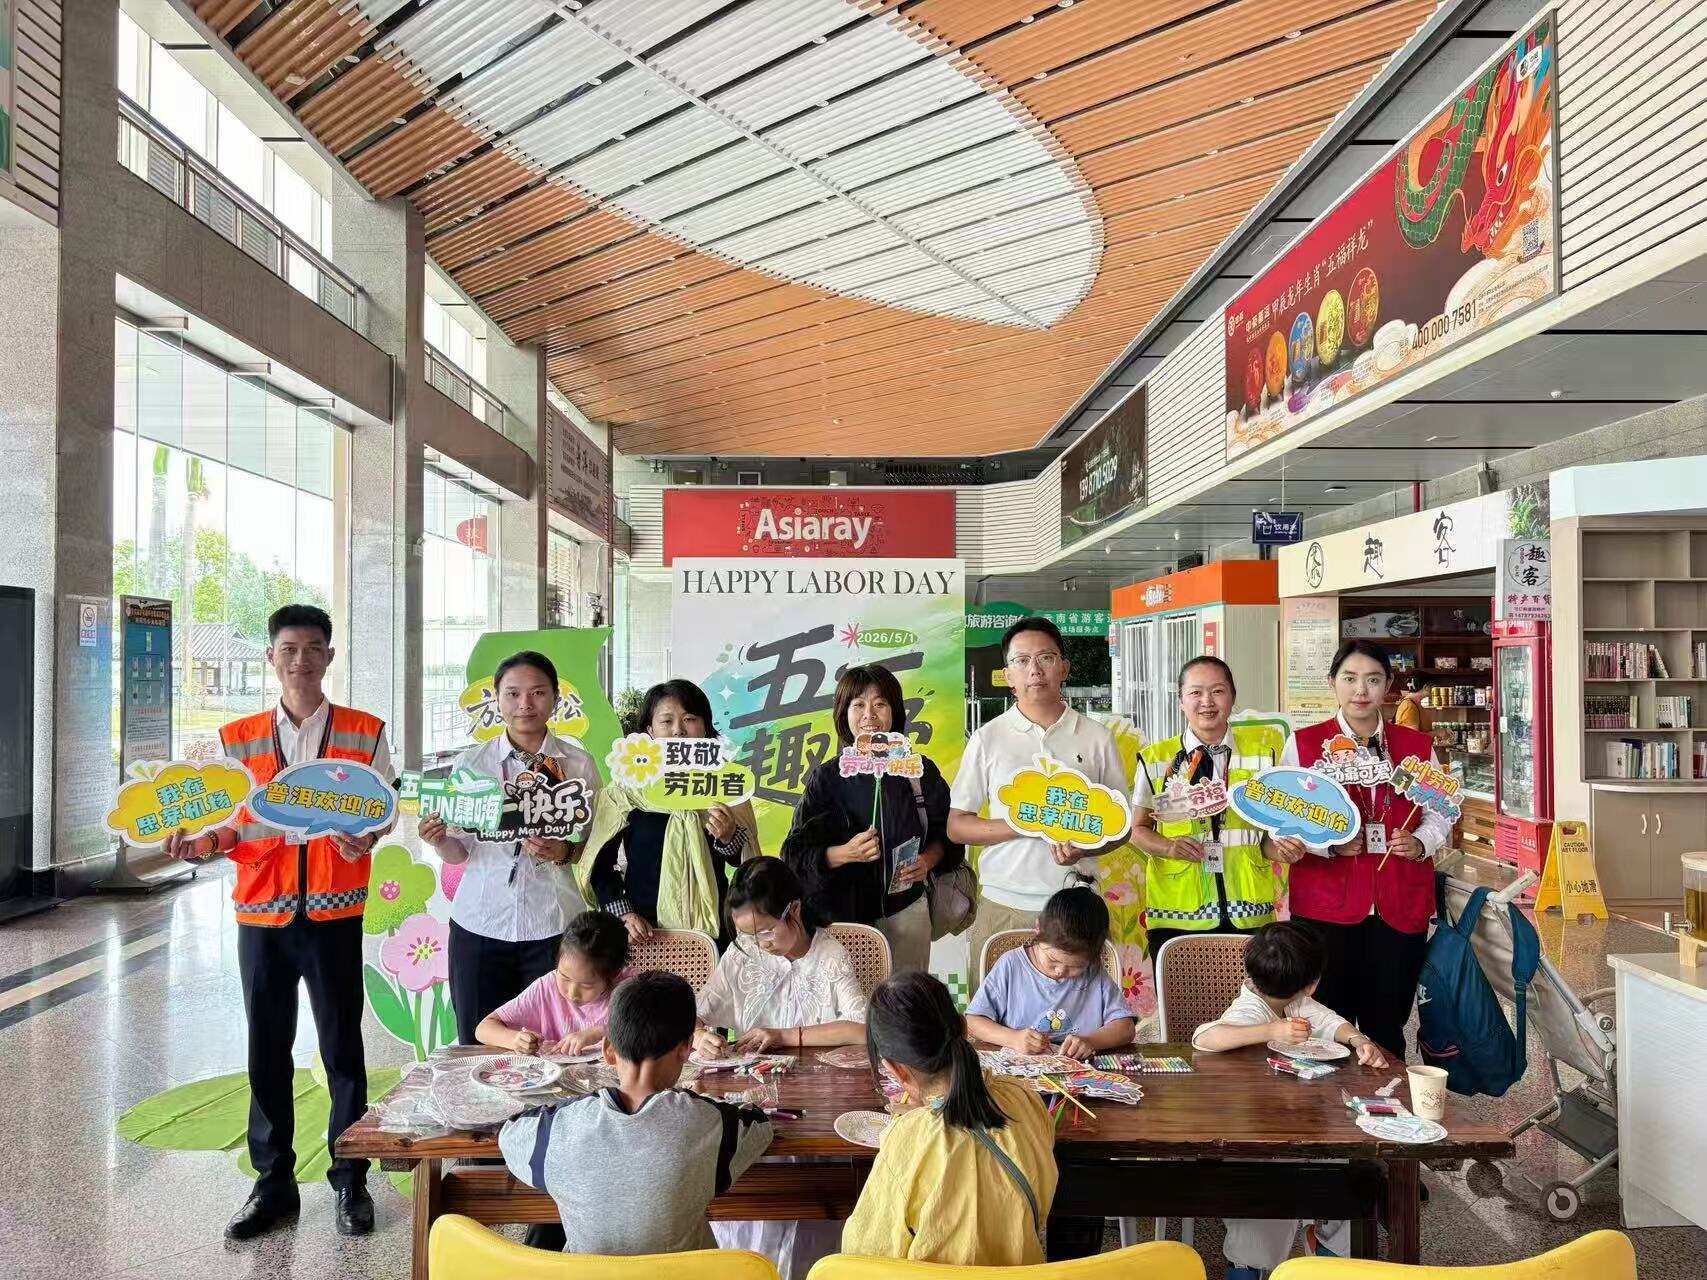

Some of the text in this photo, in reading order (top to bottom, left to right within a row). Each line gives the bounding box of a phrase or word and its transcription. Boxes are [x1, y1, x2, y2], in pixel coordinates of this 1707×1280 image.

[1411, 327, 1430, 350] 400
[1431, 314, 1450, 341] 000
[1452, 299, 1477, 330] 7581
[754, 508, 873, 550] Asiaray
[1521, 545, 1547, 586] 趣客
[682, 570, 956, 595] HAPPY LABOR DAY
[964, 613, 1024, 629] 旅游咨询
[857, 632, 914, 644] 2026/5/1
[729, 624, 925, 730] 五一
[665, 741, 721, 767] 致敬
[842, 754, 921, 776] 劳动节快乐
[155, 776, 208, 806] 我在
[401, 773, 445, 798] 五一
[663, 771, 746, 797] 劳动者
[264, 781, 387, 819] 普洱欢迎你
[1045, 785, 1089, 811] 我在
[1244, 779, 1350, 834] 普洱欢迎你
[135, 789, 232, 837] 思茅机场
[1017, 802, 1104, 836] 思茅机场
[480, 823, 571, 841] Happy May Day!
[1566, 879, 1597, 893] 小心地滑
